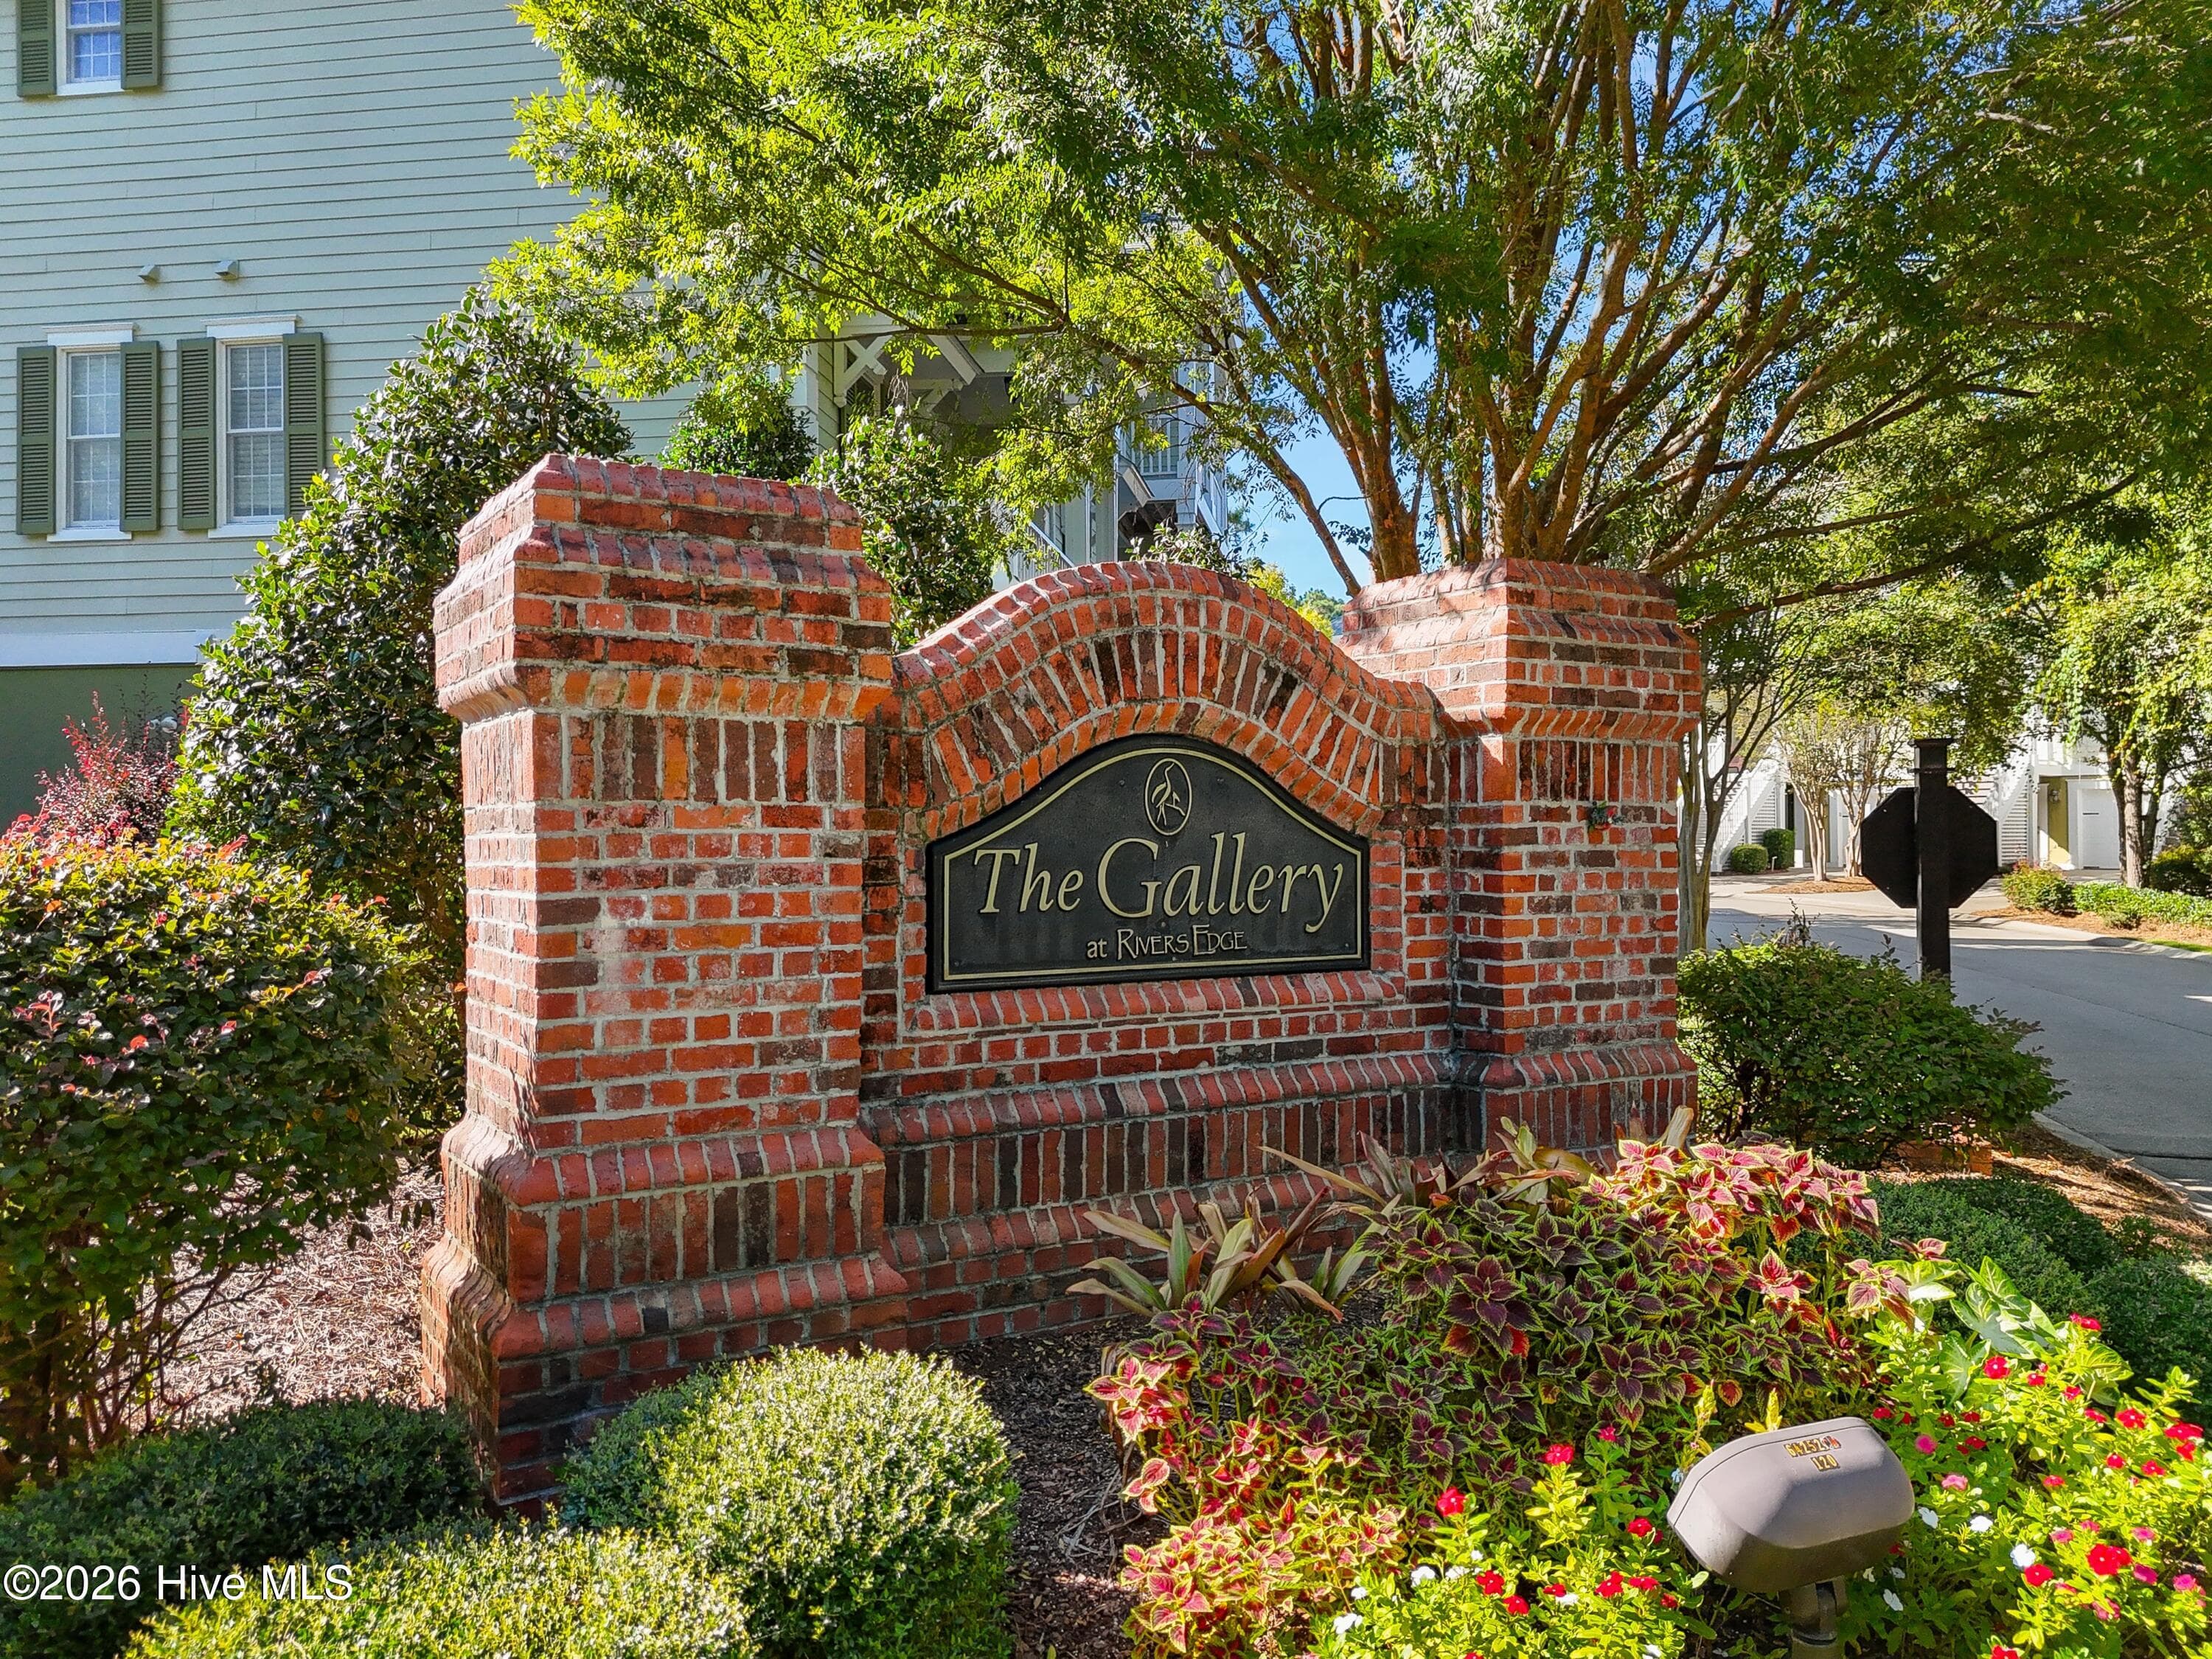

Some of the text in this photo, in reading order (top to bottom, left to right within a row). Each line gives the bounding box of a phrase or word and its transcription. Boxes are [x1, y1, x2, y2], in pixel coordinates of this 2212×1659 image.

[974, 832, 1343, 933] The Gallery
[1087, 939, 1107, 959] at
[1812, 1453, 1838, 1471] 120
